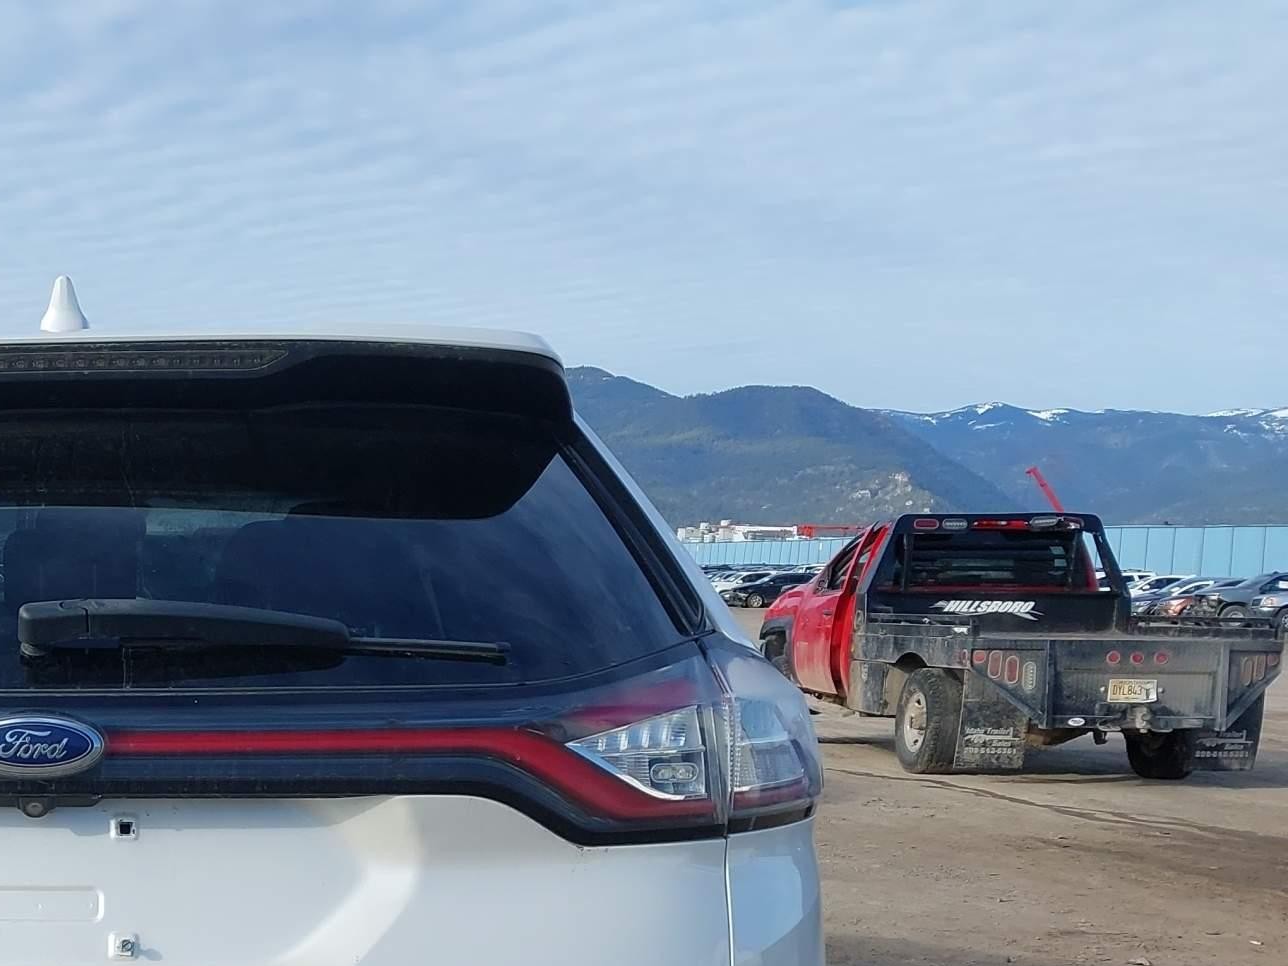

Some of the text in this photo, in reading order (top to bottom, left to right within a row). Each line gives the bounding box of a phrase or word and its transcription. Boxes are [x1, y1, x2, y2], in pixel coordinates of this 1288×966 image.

[943, 600, 1036, 613] HILLSBORO
[1112, 684, 1143, 696] DYL843
[986, 727, 1011, 735] Trailer
